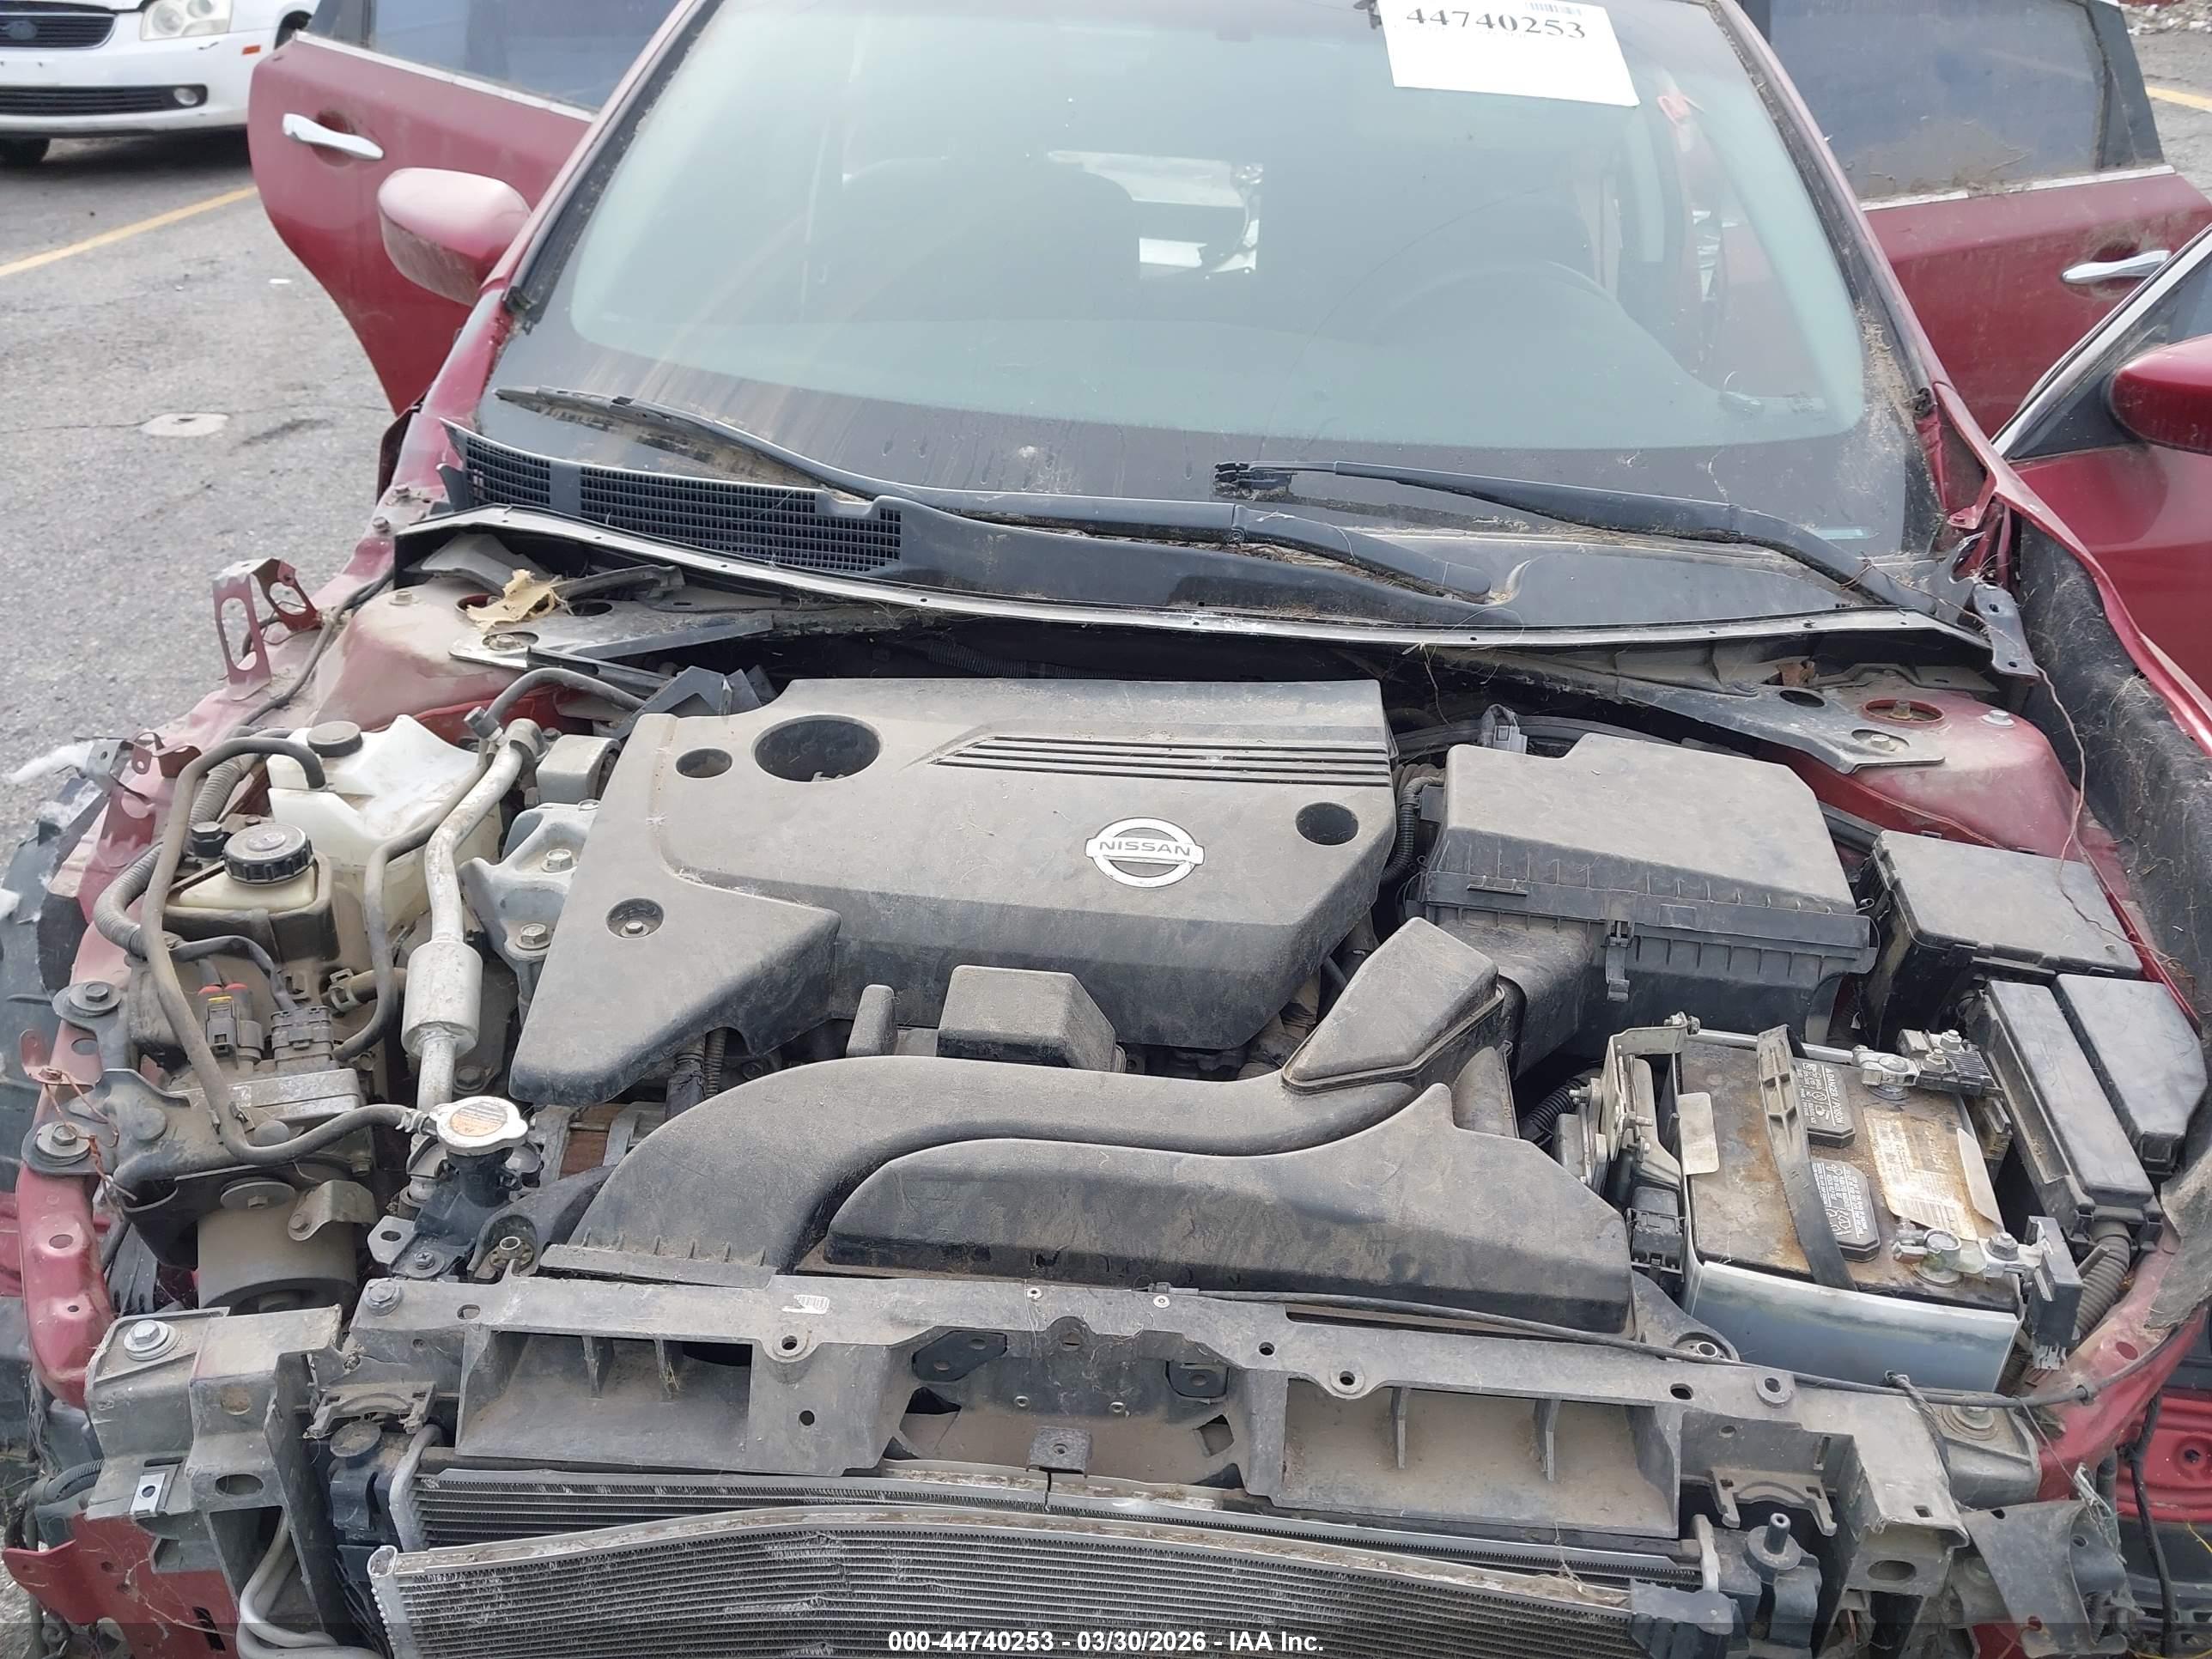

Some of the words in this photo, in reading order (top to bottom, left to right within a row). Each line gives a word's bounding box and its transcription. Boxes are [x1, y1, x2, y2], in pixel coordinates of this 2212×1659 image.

[1406, 7, 1586, 39] 44740253
[1098, 841, 1191, 857] NISSAN
[1826, 1073, 1839, 1097] DANGER
[1832, 1102, 1845, 1126] POISON
